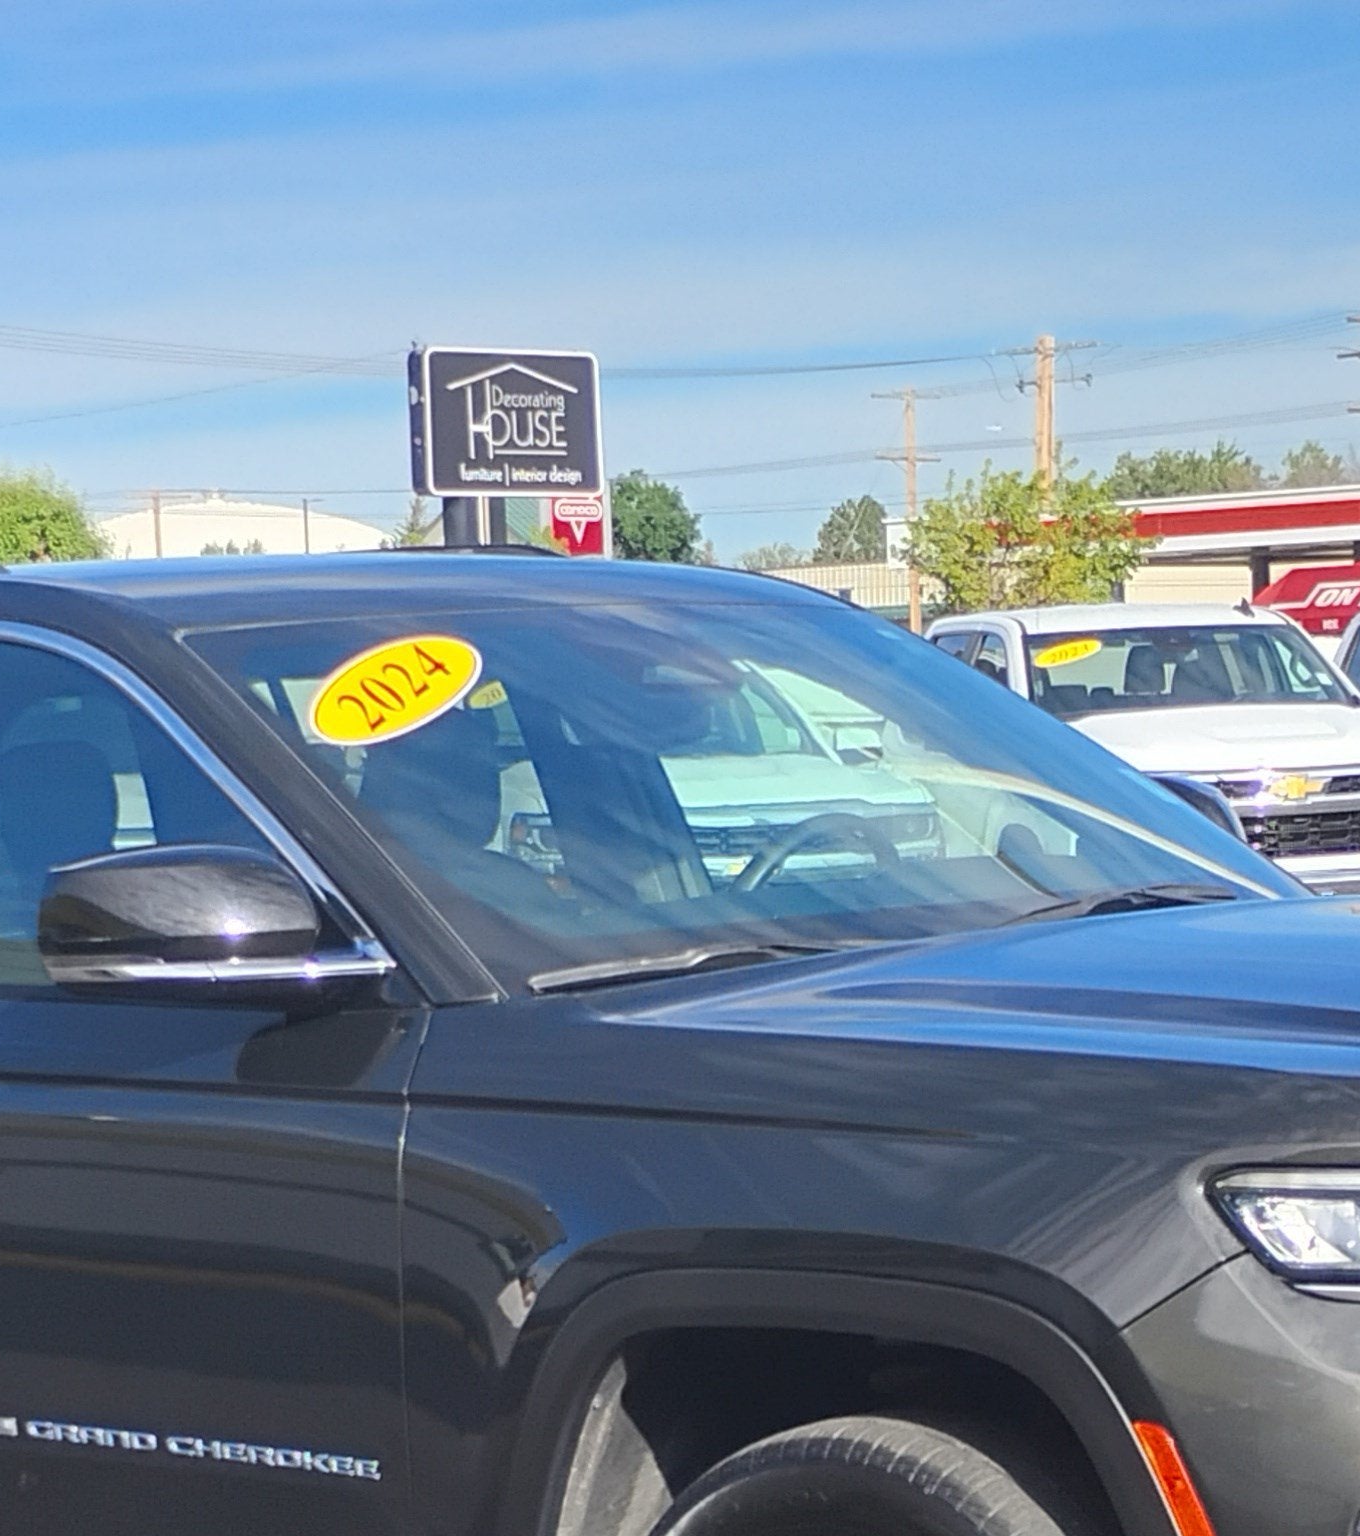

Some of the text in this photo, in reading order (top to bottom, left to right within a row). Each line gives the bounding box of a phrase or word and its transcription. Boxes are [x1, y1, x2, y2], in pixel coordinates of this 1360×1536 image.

[492, 384, 565, 412] Decorating
[511, 464, 547, 482] interior
[548, 464, 583, 486] design
[338, 644, 451, 731] 2024
[25, 1418, 382, 1481] GRAND CHEROKEE
